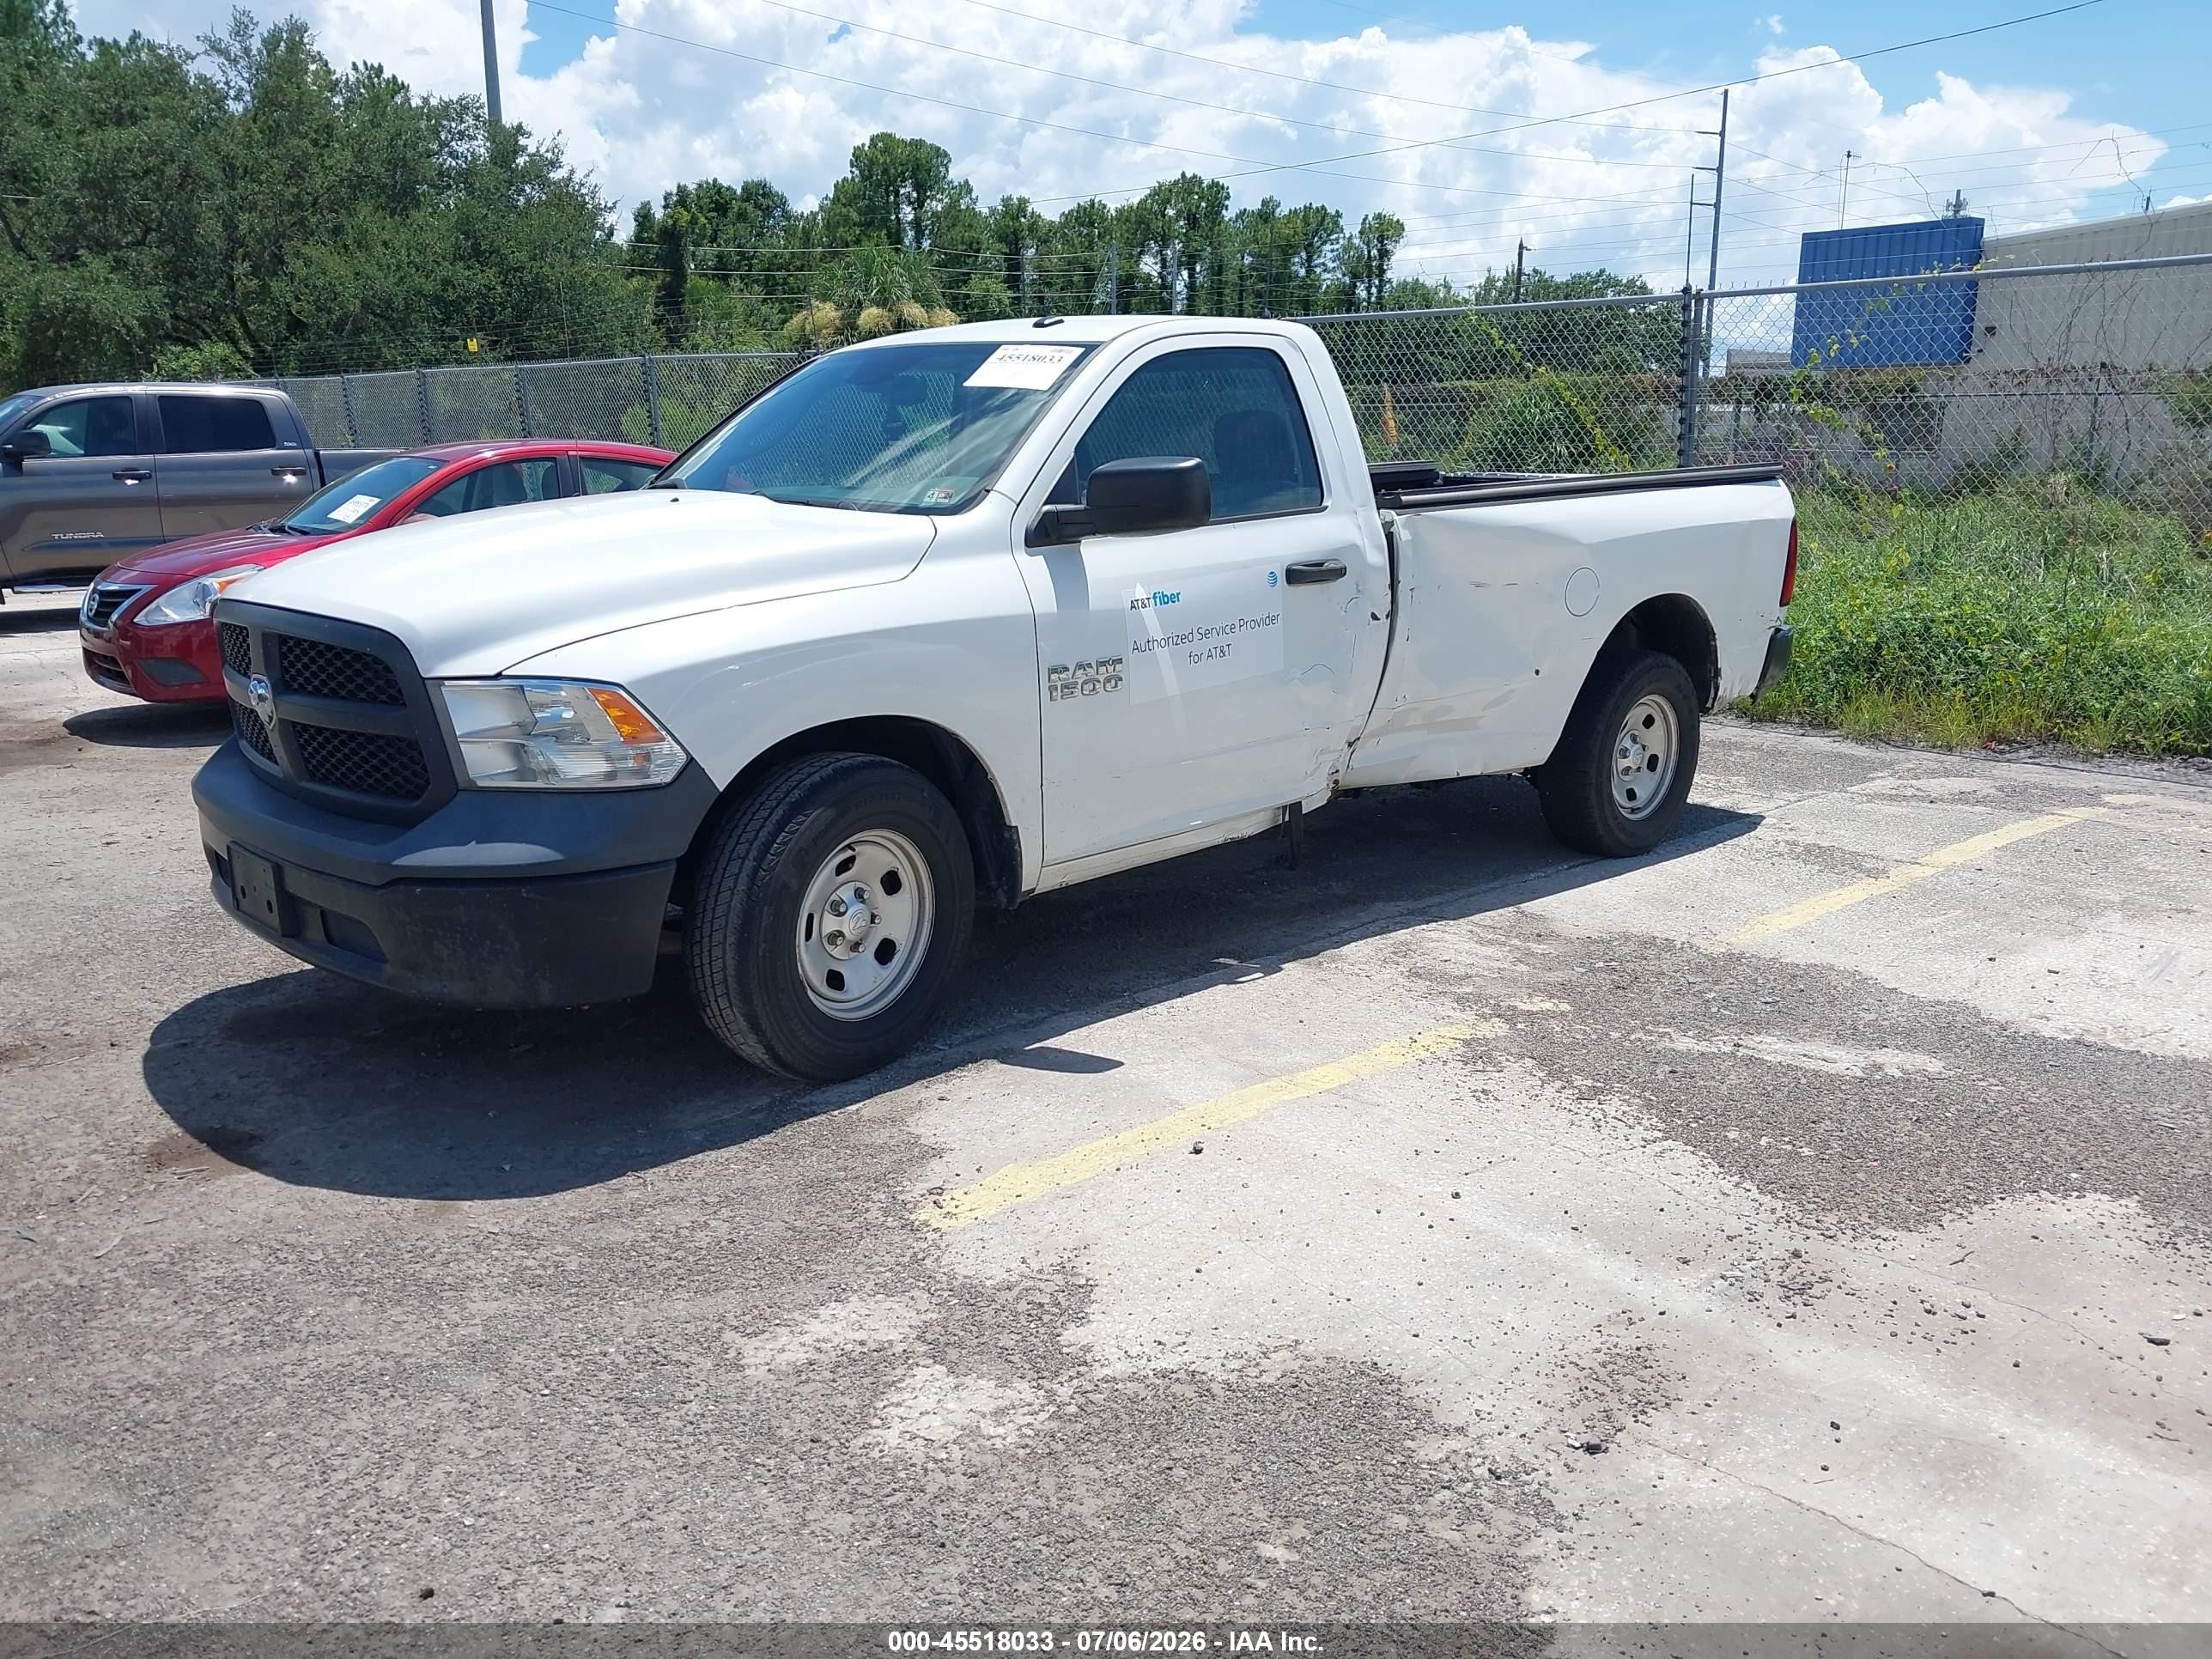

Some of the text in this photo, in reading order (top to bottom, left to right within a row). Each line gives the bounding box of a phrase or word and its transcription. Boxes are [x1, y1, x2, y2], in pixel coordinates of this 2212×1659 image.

[996, 353, 1065, 364] 45518033
[1129, 590, 1182, 611] AT&T fiber
[1131, 611, 1281, 654] Authorized Service Provider
[1188, 643, 1233, 665] for AT&T
[1047, 655, 1124, 684] RAM
[1048, 675, 1124, 702] 1500
